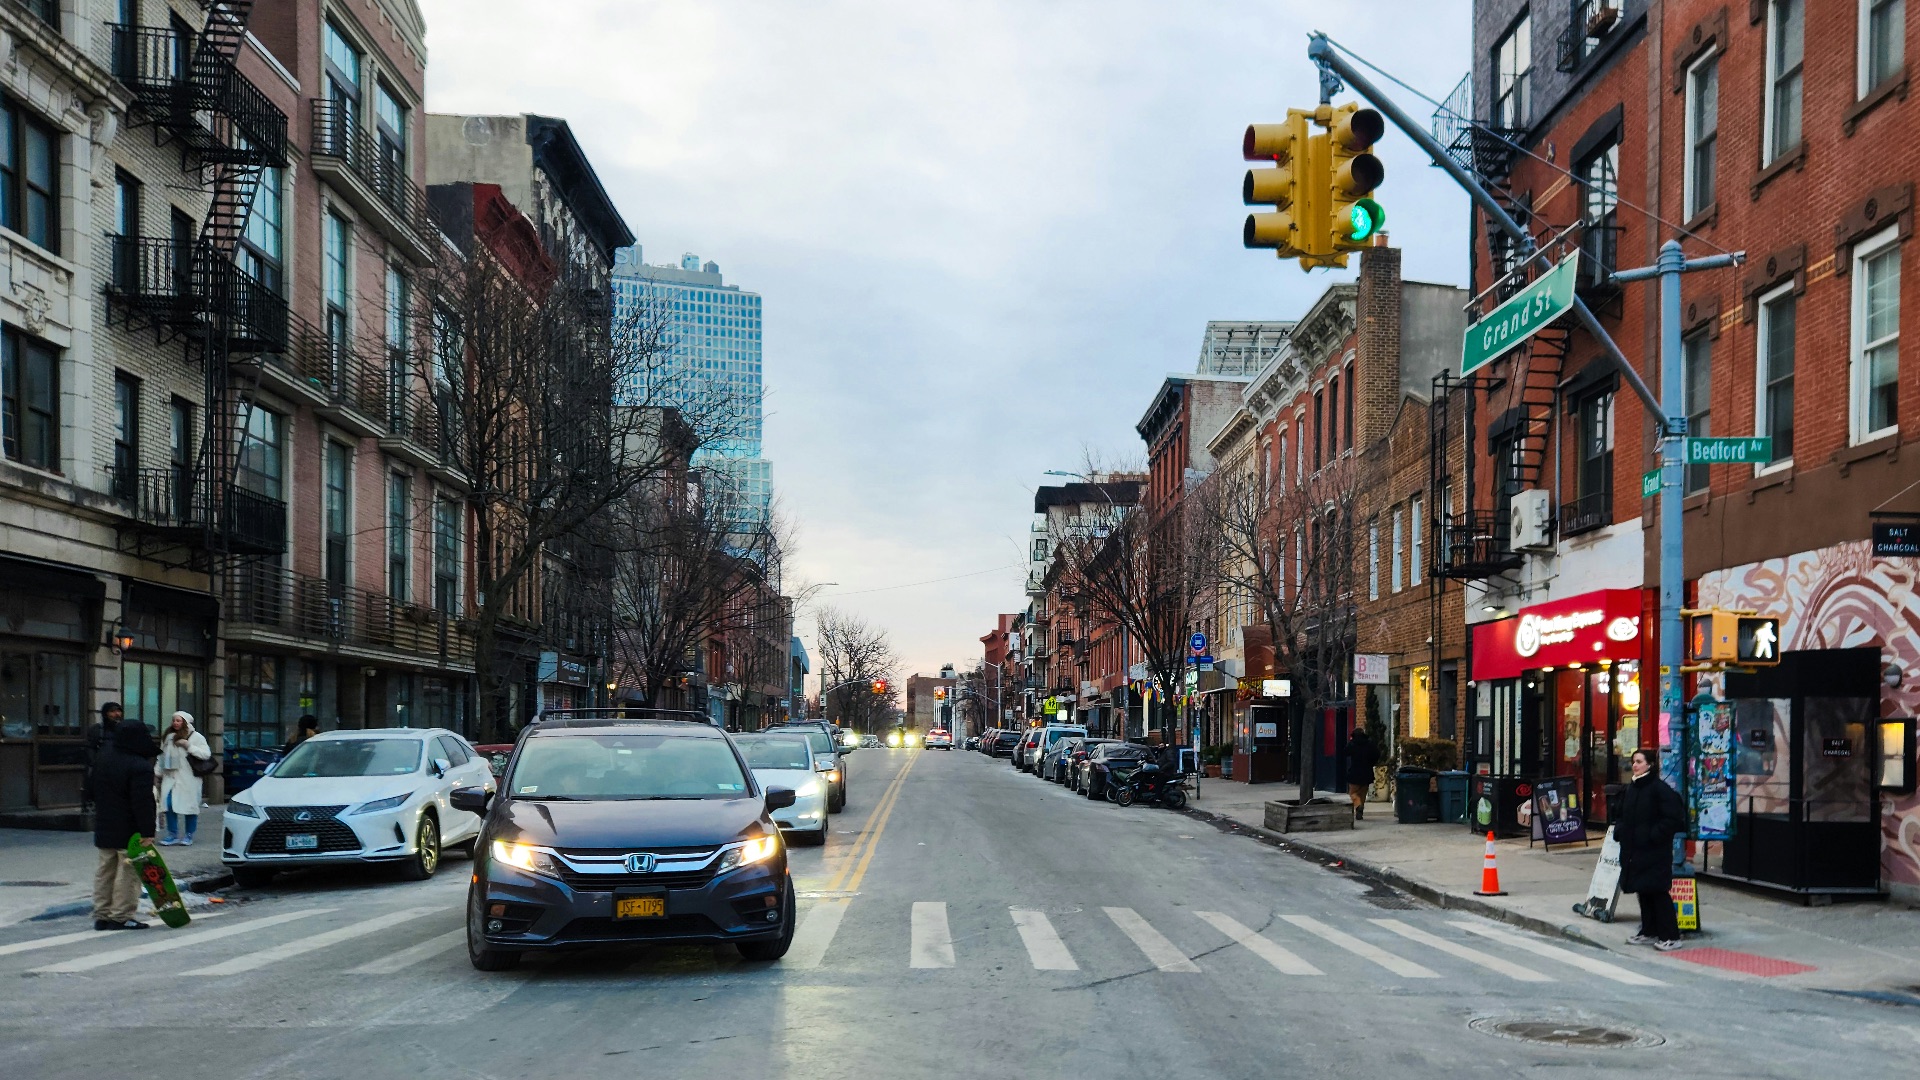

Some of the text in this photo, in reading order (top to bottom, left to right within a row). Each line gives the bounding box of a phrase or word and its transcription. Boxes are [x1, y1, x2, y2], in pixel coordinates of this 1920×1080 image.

[1483, 284, 1552, 351] Grand St
[1693, 440, 1763, 460] Bedford Av
[1644, 472, 1660, 495] Grand
[1889, 528, 1908, 537] SALT
[1877, 543, 1920, 553] CHARCOAL
